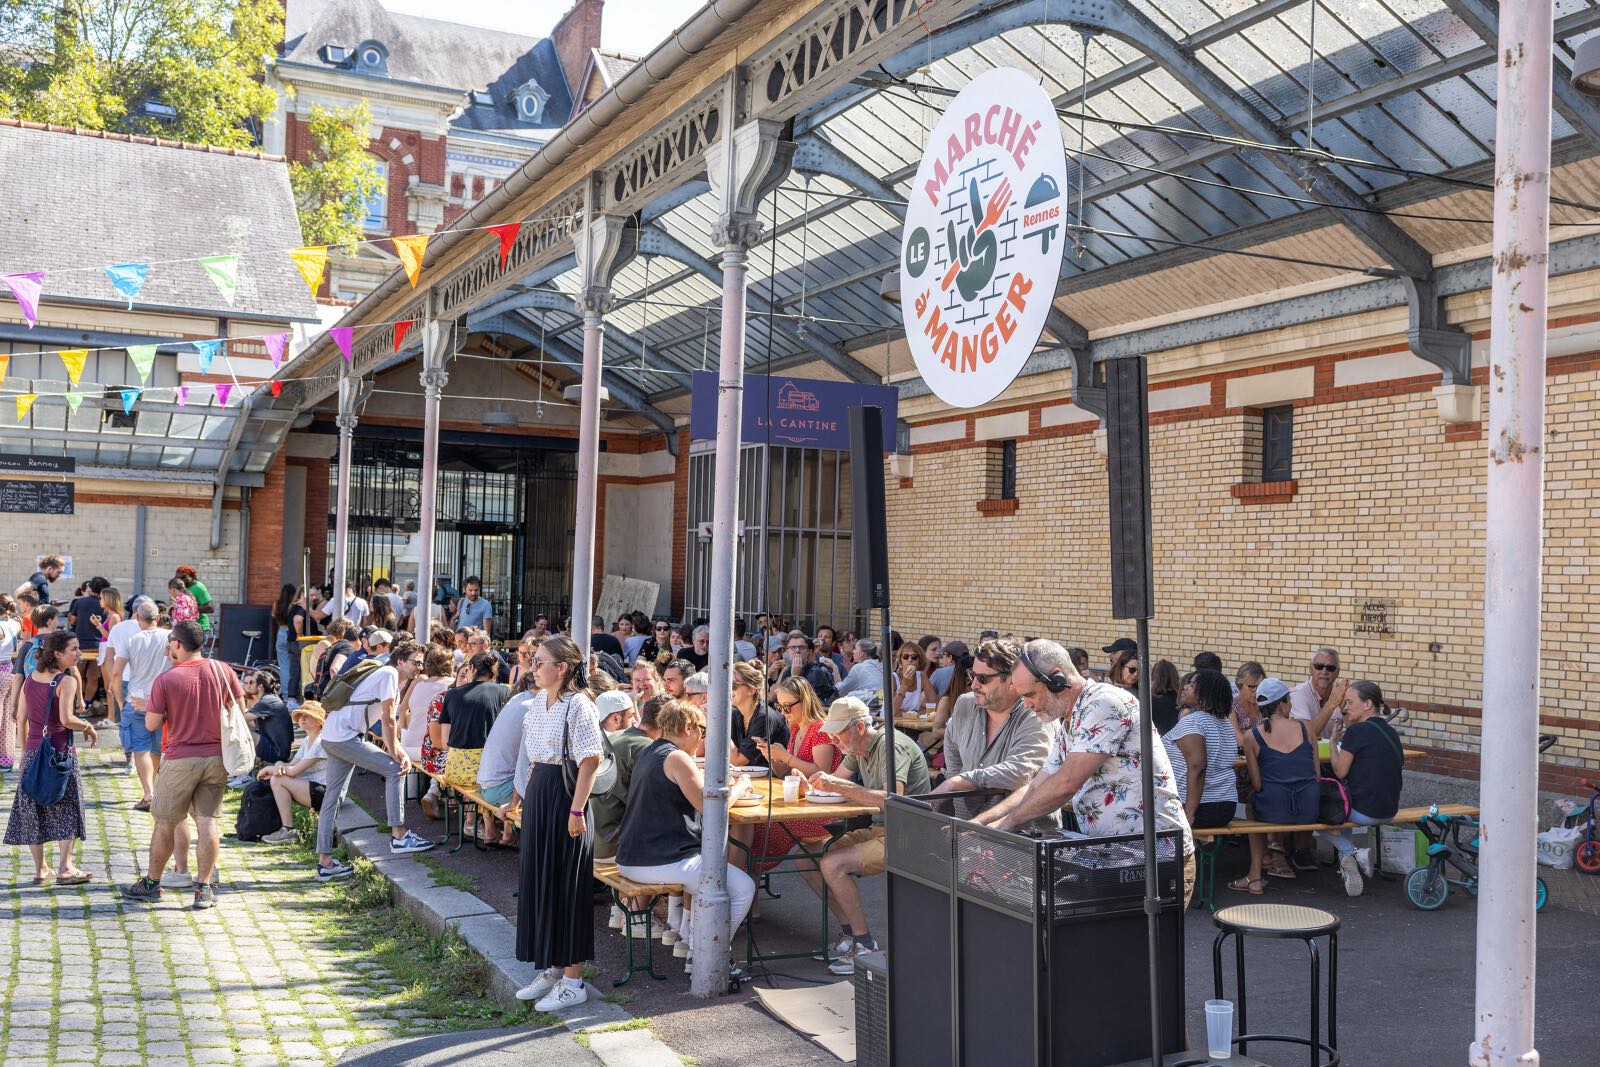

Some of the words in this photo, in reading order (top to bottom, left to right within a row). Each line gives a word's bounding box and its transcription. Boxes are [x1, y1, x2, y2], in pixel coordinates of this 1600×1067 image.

[925, 105, 1041, 207] MARCHÉ
[1024, 206, 1060, 228] Rennes
[910, 241, 926, 264] LE
[924, 271, 1033, 374] MANGER
[757, 416, 773, 427] LA
[780, 418, 837, 431] CANTINE
[1363, 601, 1385, 611] Accès
[1361, 612, 1387, 622] interdit
[1368, 624, 1391, 635] public
